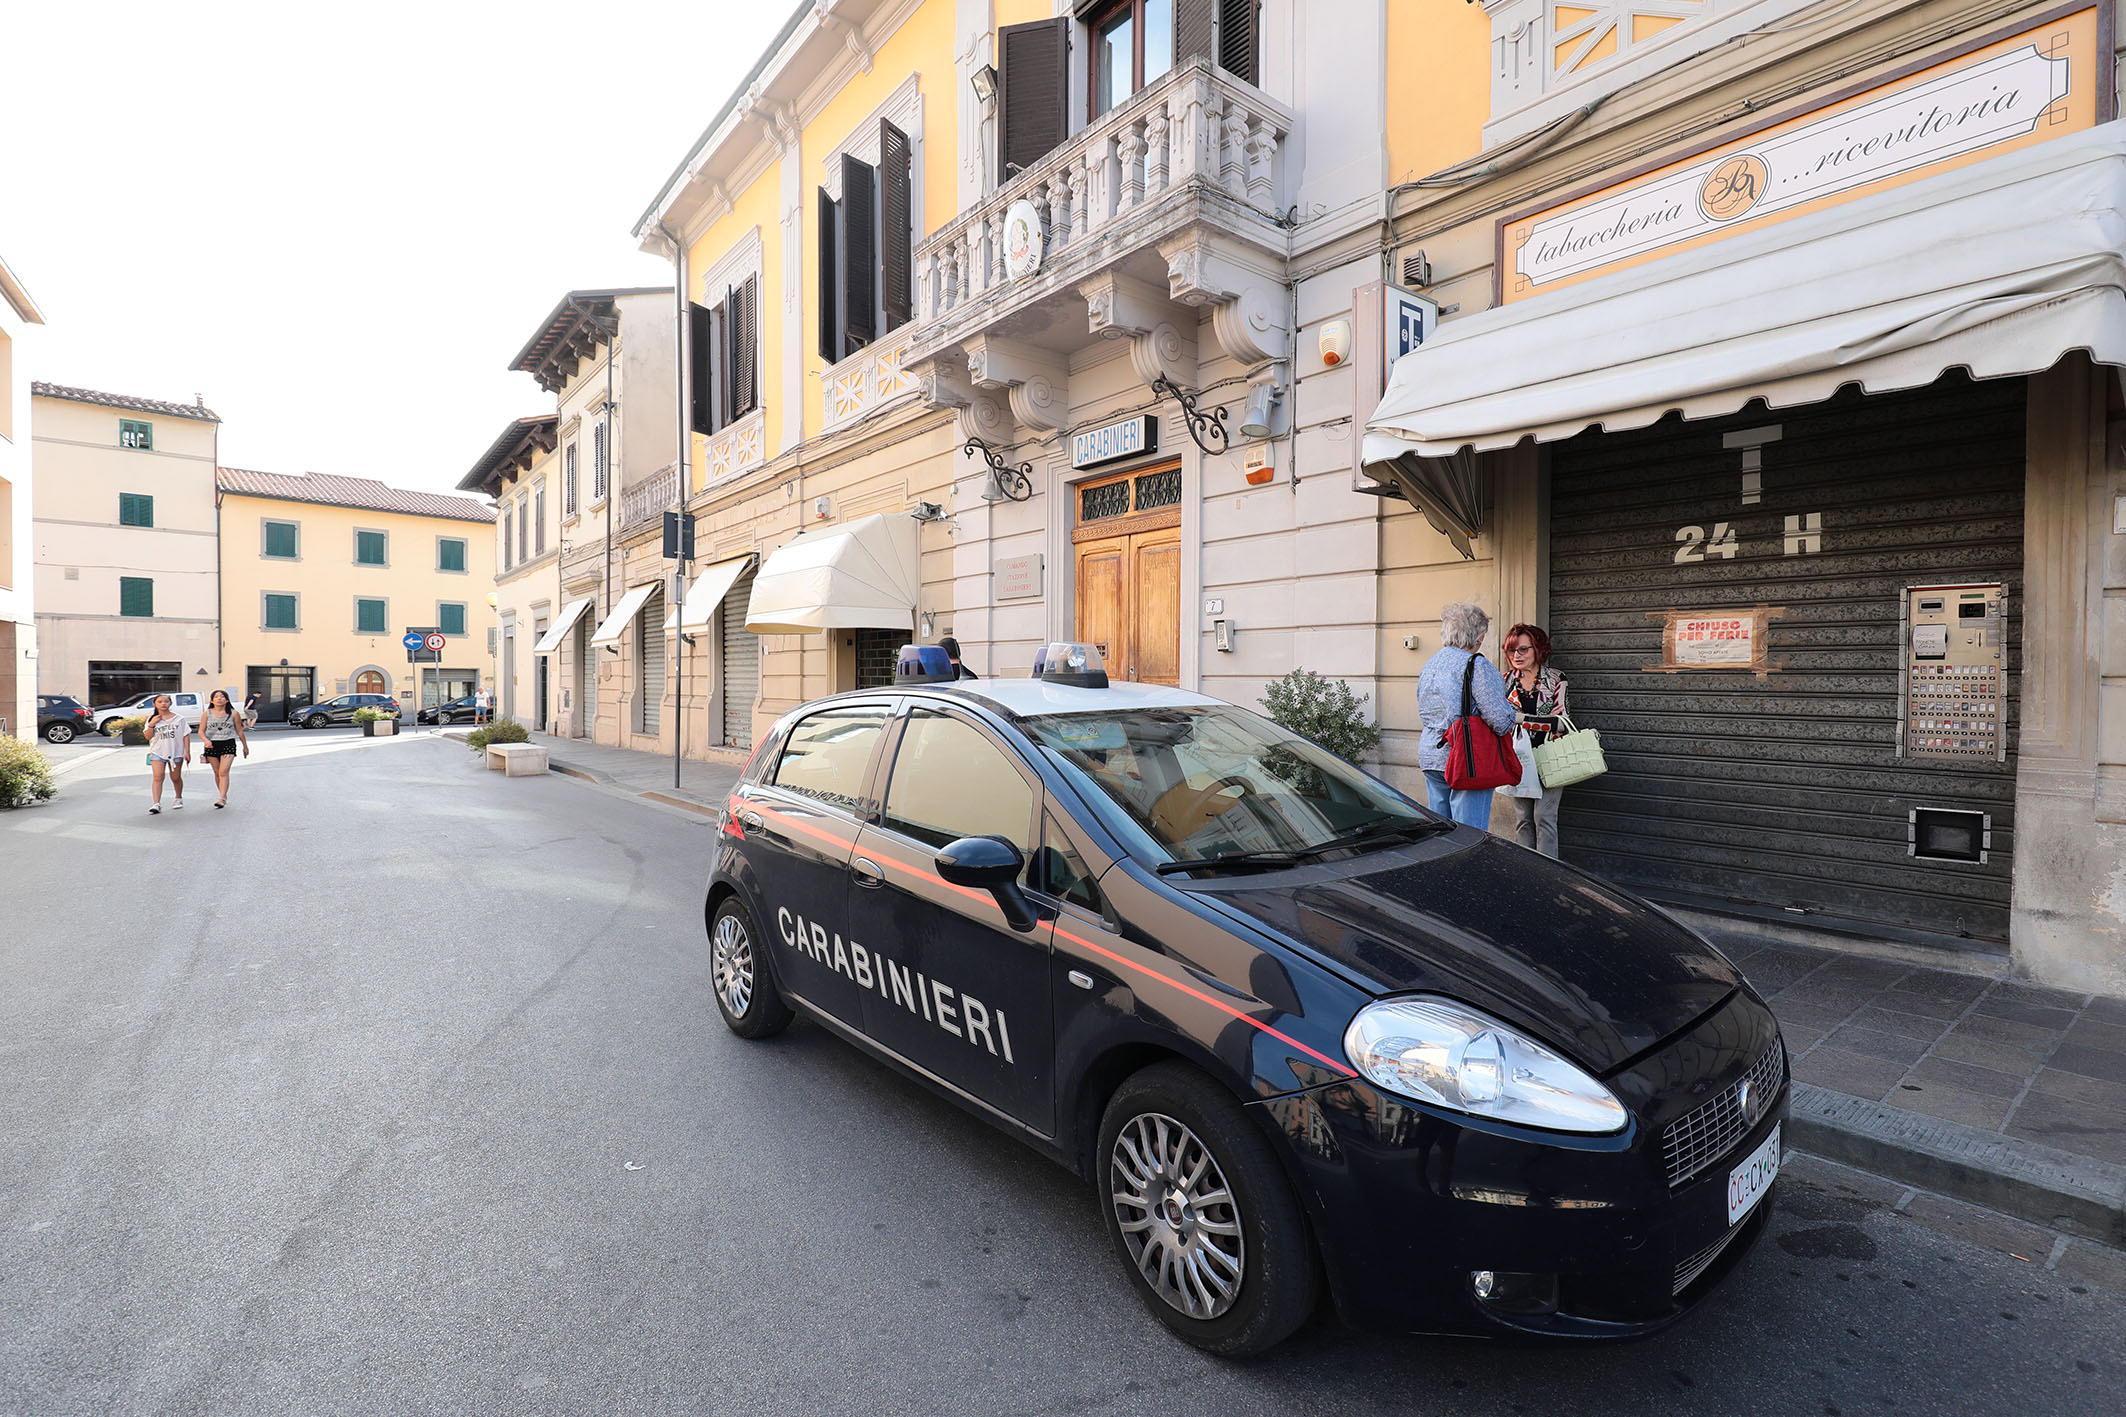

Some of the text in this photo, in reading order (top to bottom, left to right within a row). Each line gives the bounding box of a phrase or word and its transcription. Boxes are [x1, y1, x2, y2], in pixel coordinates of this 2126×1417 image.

[1535, 199, 1684, 265] tabaccheria
[1077, 419, 1140, 464] CARABINIERI
[1722, 423, 1783, 505] T
[1674, 512, 1822, 563] 24 H
[1211, 600, 1217, 611] 7
[1687, 620, 1741, 631] CHIUSO
[1678, 629, 1749, 641] PER FERIE
[778, 906, 1014, 1065] CARABINIERI
